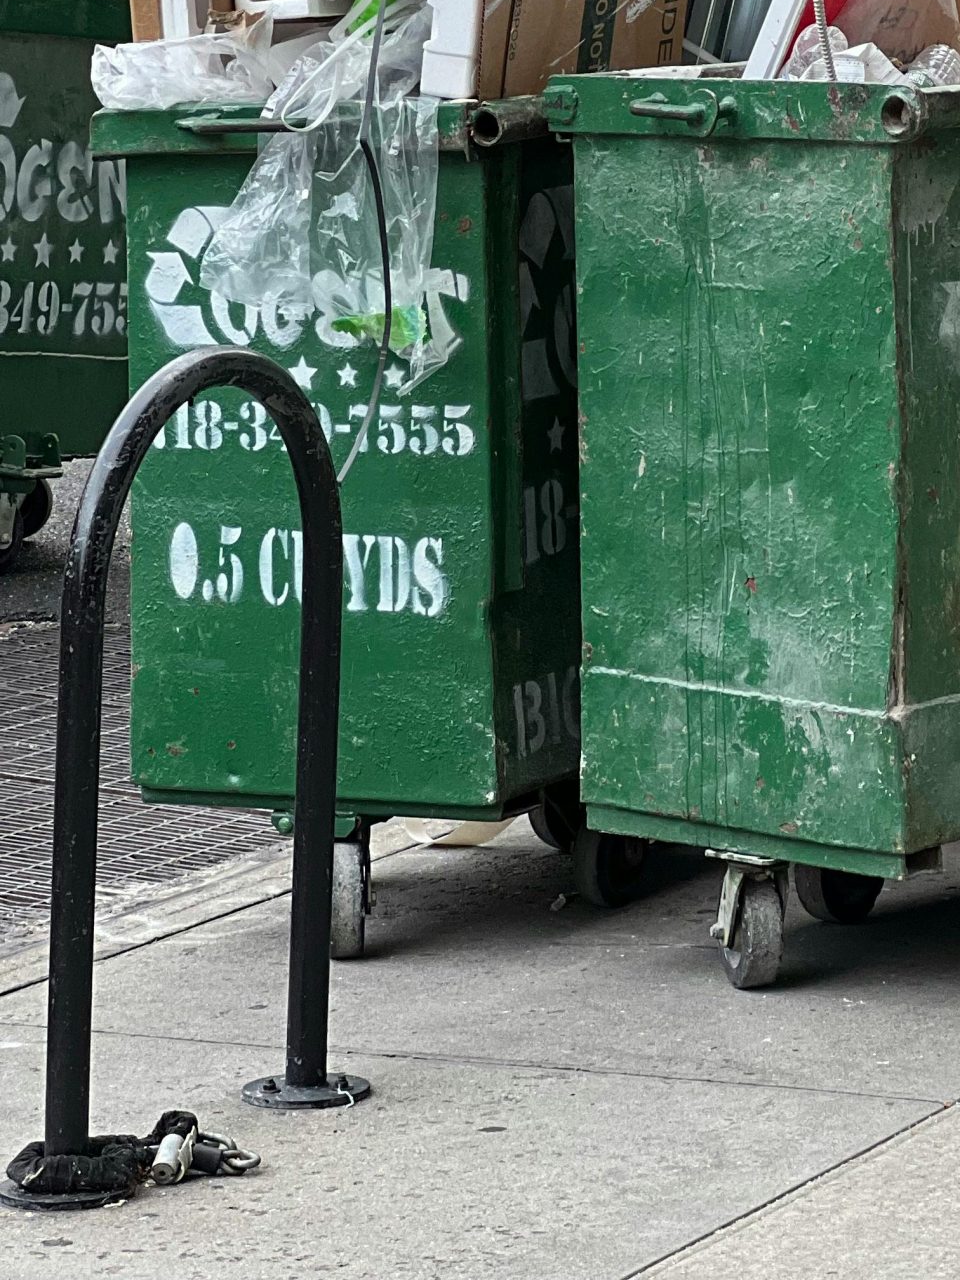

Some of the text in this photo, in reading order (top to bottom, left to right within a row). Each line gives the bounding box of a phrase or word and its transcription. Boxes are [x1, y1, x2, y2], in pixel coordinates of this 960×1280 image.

[153, 400, 475, 456] 18-3-7555
[170, 521, 244, 603] 0.5
[342, 532, 448, 617] YDS
